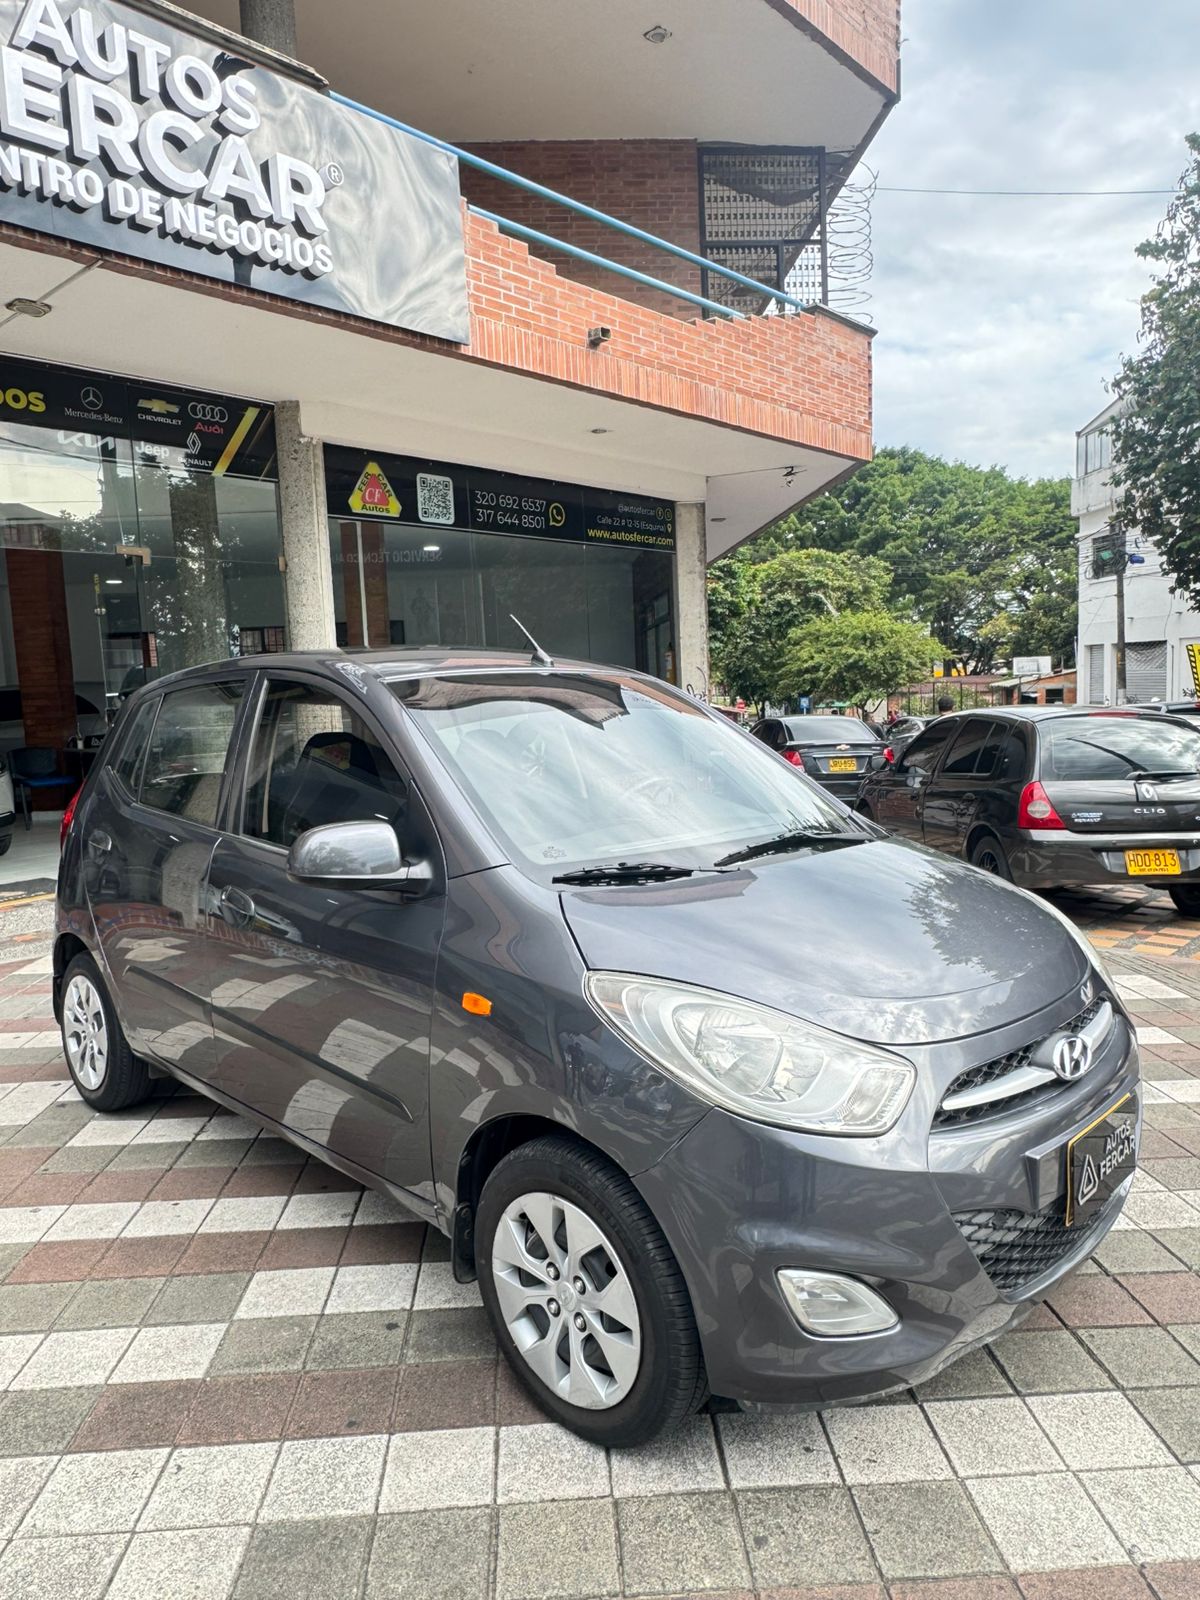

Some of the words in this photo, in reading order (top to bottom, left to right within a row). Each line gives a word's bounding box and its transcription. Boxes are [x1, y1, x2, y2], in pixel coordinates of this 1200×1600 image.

[13, 0, 261, 136] AUTOS
[107, 178, 164, 228] DE
[165, 198, 334, 276] NEGOCIOS
[0, 387, 47, 413] OS
[63, 407, 124, 424] Mercedes-Benz
[137, 413, 182, 426] CHEVROLET
[194, 421, 224, 435] Audi
[135, 440, 170, 459] Jeep
[357, 471, 372, 493] FER
[376, 472, 393, 498] CAR
[361, 503, 391, 514] Autos
[474, 490, 496, 506] 320
[498, 494, 520, 510] 692
[521, 497, 547, 513] 6537
[476, 508, 494, 523] 317
[497, 511, 520, 526] 644
[521, 514, 546, 529] 8501
[587, 528, 674, 547] www.autosfercar.com
[1106, 1120, 1131, 1154] AUTOS
[1100, 1134, 1136, 1180] FERCAR
